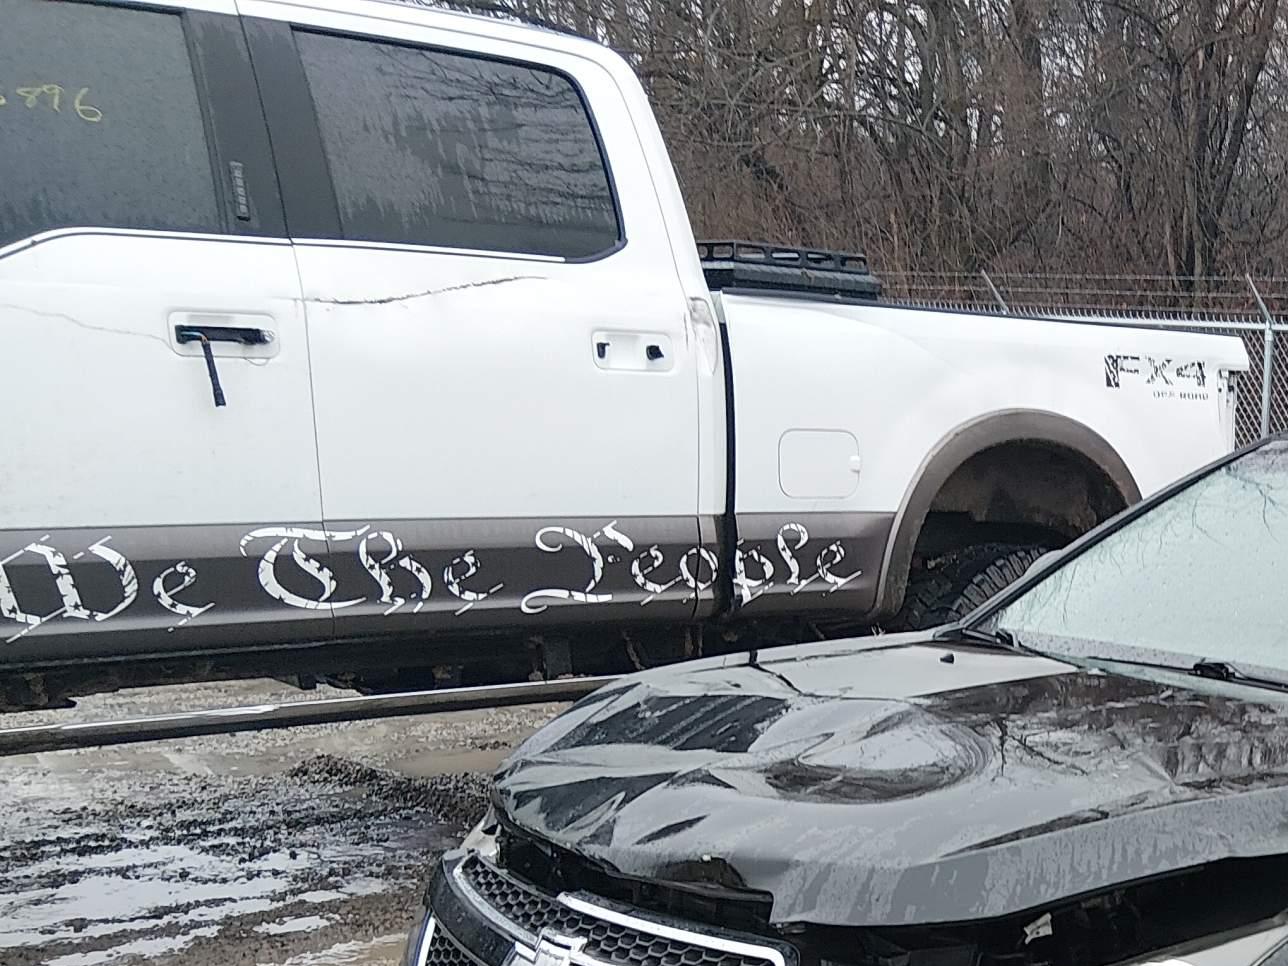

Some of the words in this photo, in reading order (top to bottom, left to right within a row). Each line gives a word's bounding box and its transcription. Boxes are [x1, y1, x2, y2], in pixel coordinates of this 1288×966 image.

[1104, 354, 1206, 388] FX4
[0, 535, 216, 643] We
[239, 523, 504, 617] The
[520, 519, 863, 615] People
